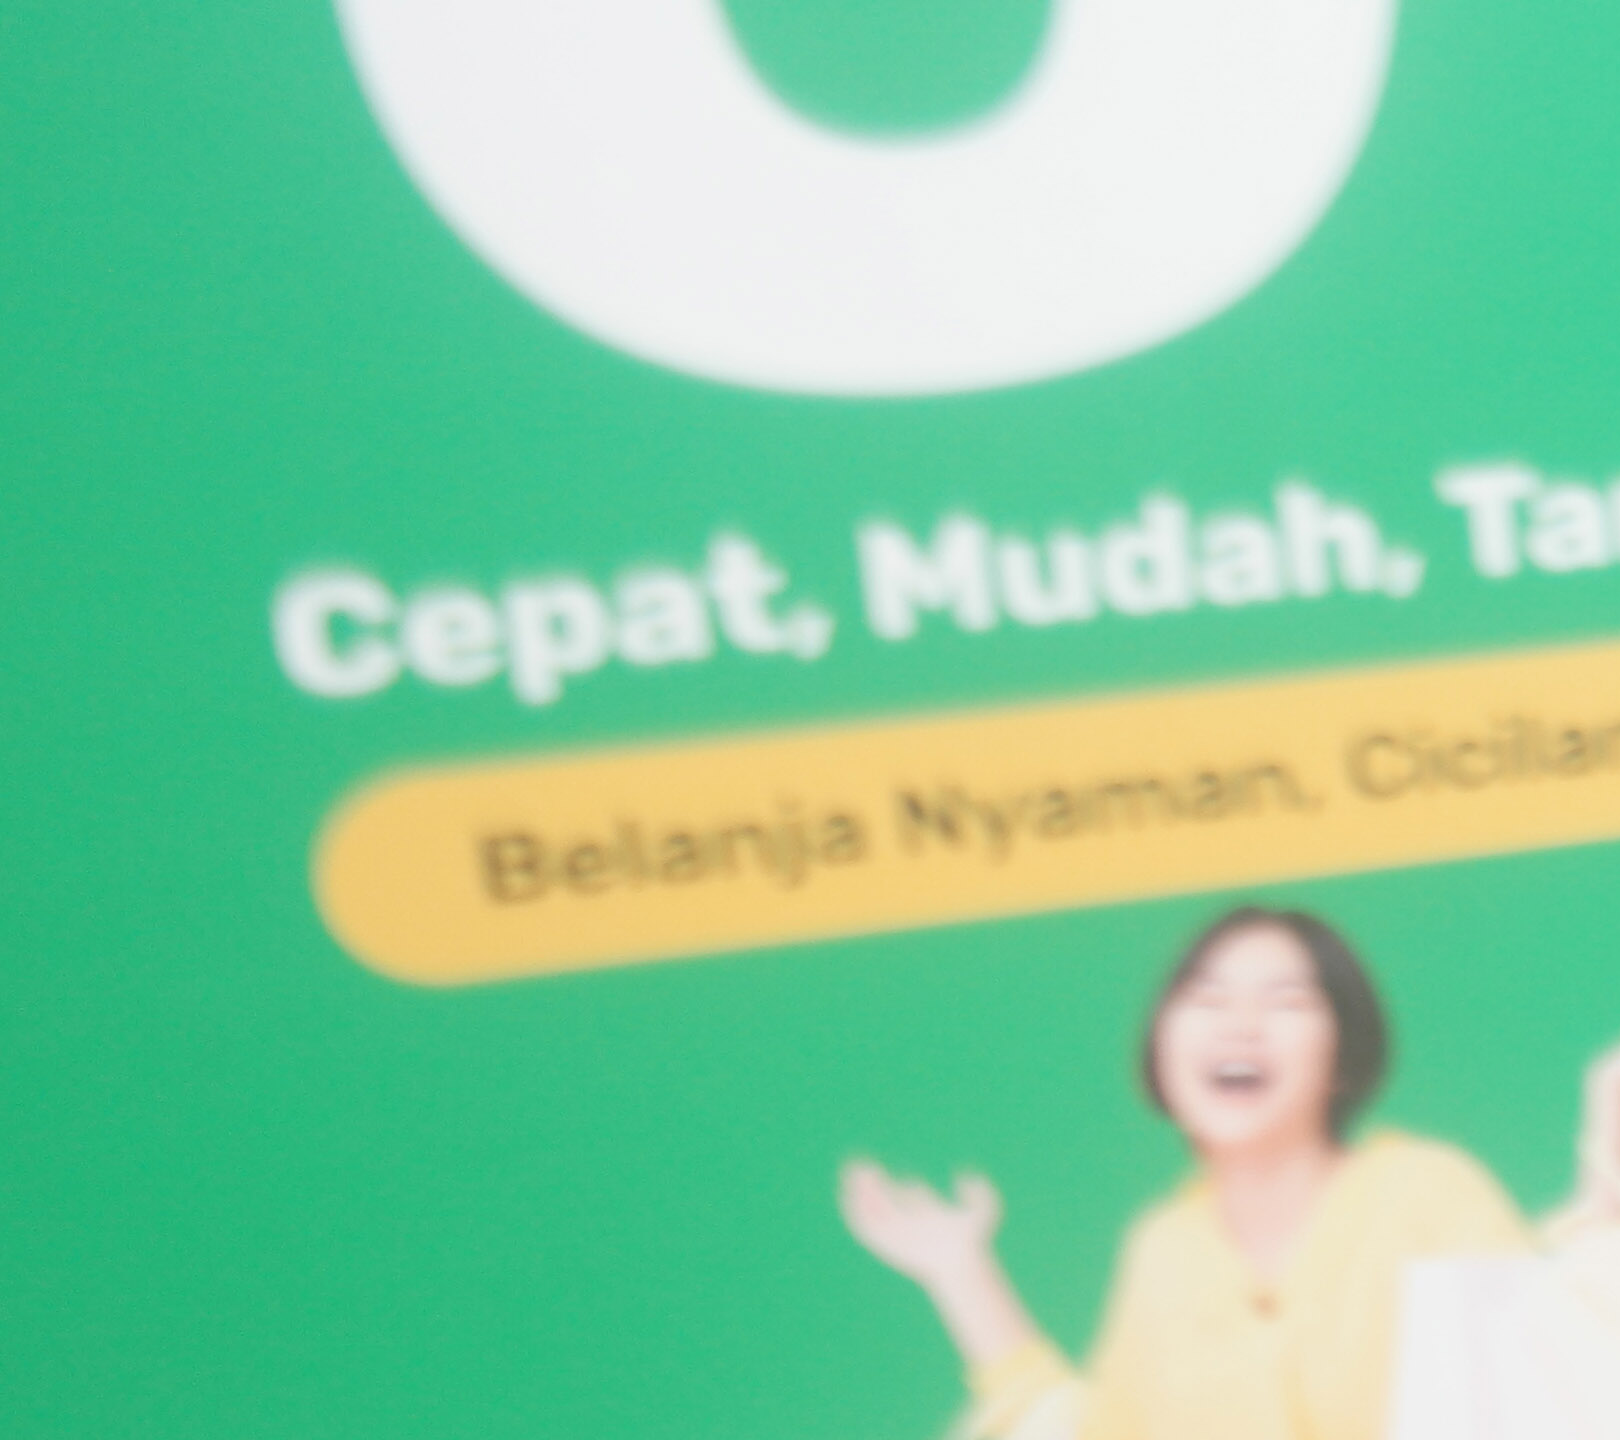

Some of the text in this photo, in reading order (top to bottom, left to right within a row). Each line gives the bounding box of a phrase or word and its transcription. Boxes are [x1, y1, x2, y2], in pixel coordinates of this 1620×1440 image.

[269, 528, 836, 708] Cepat,
[853, 481, 1428, 643] Mudah,
[477, 800, 873, 908] Belanja
